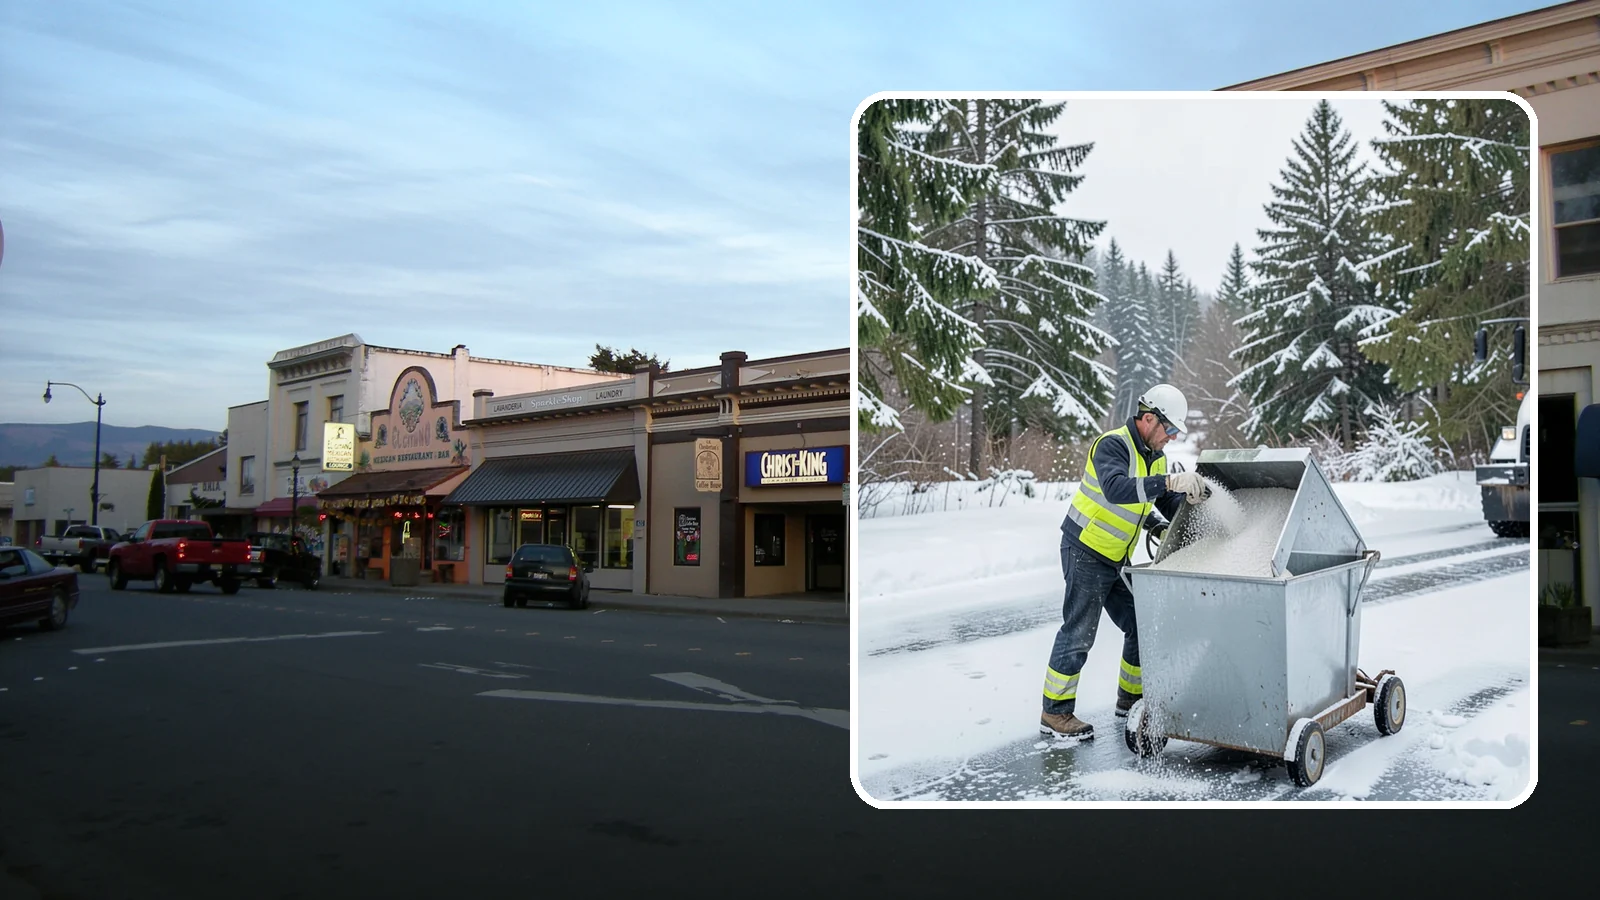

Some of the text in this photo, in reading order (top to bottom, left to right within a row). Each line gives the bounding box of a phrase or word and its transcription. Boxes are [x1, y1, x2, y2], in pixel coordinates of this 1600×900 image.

[596, 389, 623, 399] LAUNDRY
[561, 395, 582, 405] Shop
[494, 402, 522, 412] LAVANDERIA
[373, 454, 398, 464] MEXICAN
[398, 451, 433, 462] RESTAURANT
[438, 450, 450, 459] BAR
[761, 450, 827, 478] CHRIST KING
